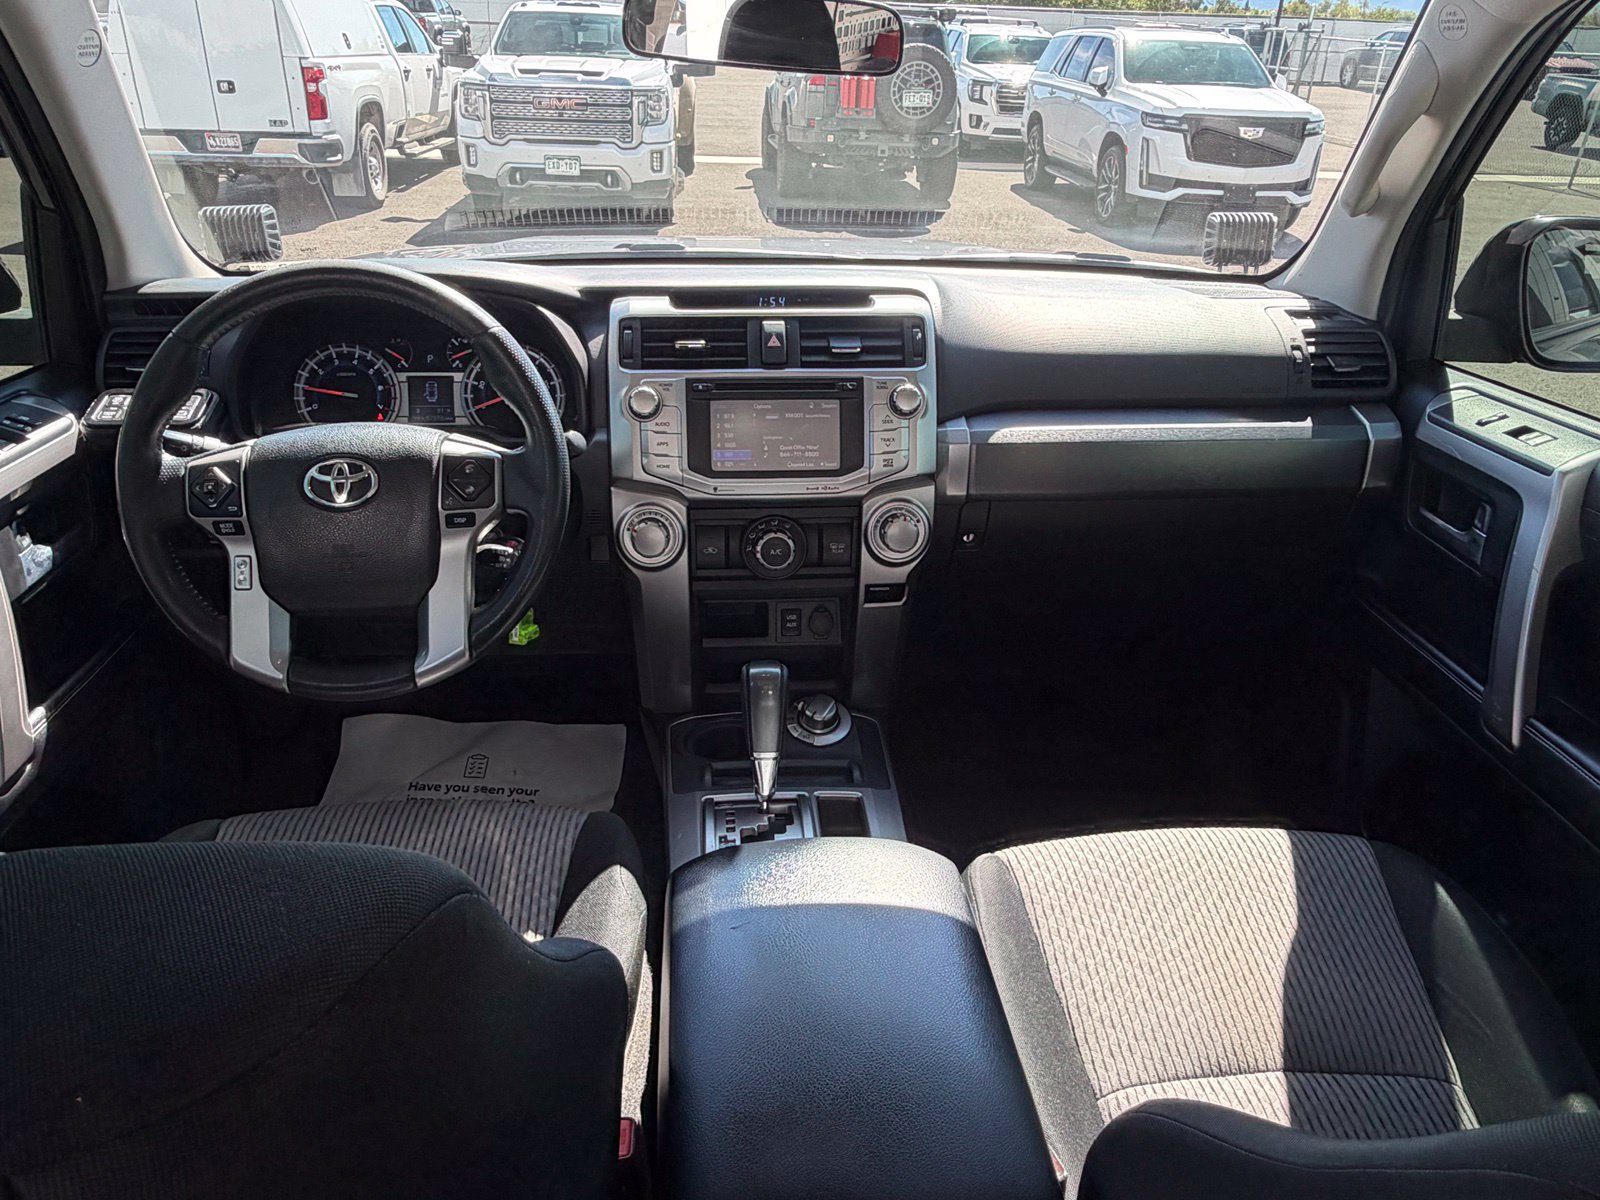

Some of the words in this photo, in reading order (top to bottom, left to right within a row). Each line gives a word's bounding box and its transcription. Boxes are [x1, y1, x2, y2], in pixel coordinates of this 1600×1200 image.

[533, 97, 588, 111] GMC
[759, 296, 786, 308] 1:54
[407, 781, 442, 792] Have
[443, 783, 470, 794] you
[473, 785, 505, 795] seen
[507, 787, 540, 798] your
